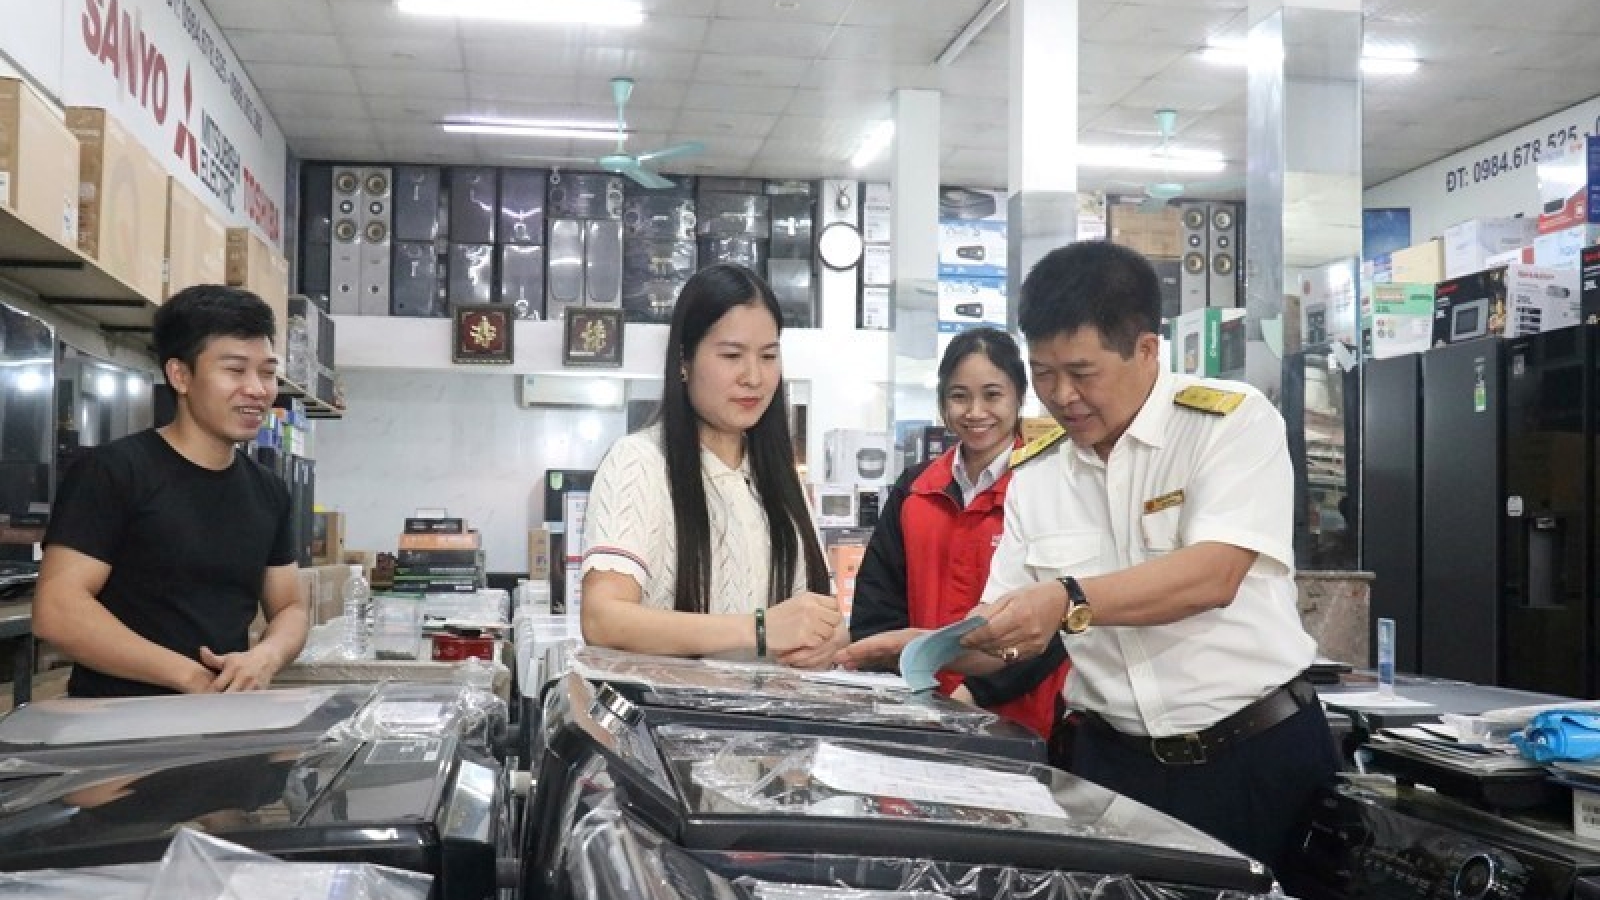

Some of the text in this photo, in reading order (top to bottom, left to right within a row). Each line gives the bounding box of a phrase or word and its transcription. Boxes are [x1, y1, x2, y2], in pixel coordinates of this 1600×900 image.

[82, 0, 168, 126] SANYO
[1446, 165, 1469, 193] ĐT:
[1473, 124, 1578, 183] 0984.678525
